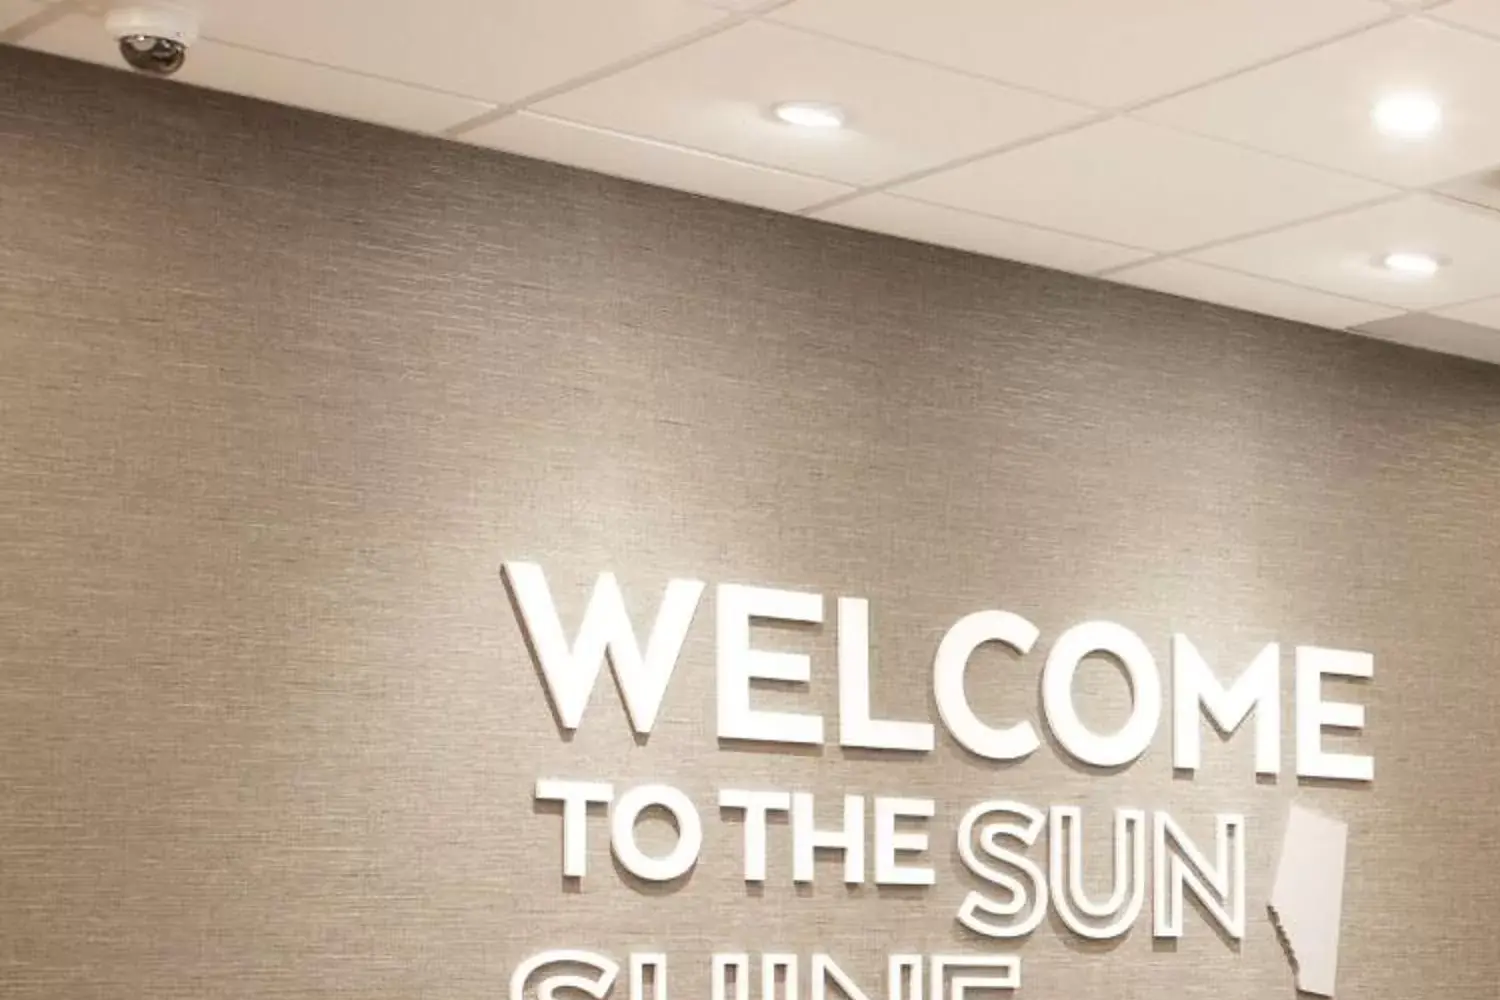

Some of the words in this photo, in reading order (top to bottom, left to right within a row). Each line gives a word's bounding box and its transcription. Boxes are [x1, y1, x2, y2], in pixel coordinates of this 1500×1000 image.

[501, 560, 1375, 782] WELCOME
[535, 778, 703, 882] TO
[719, 787, 936, 886] THE
[955, 800, 1246, 940] SUN
